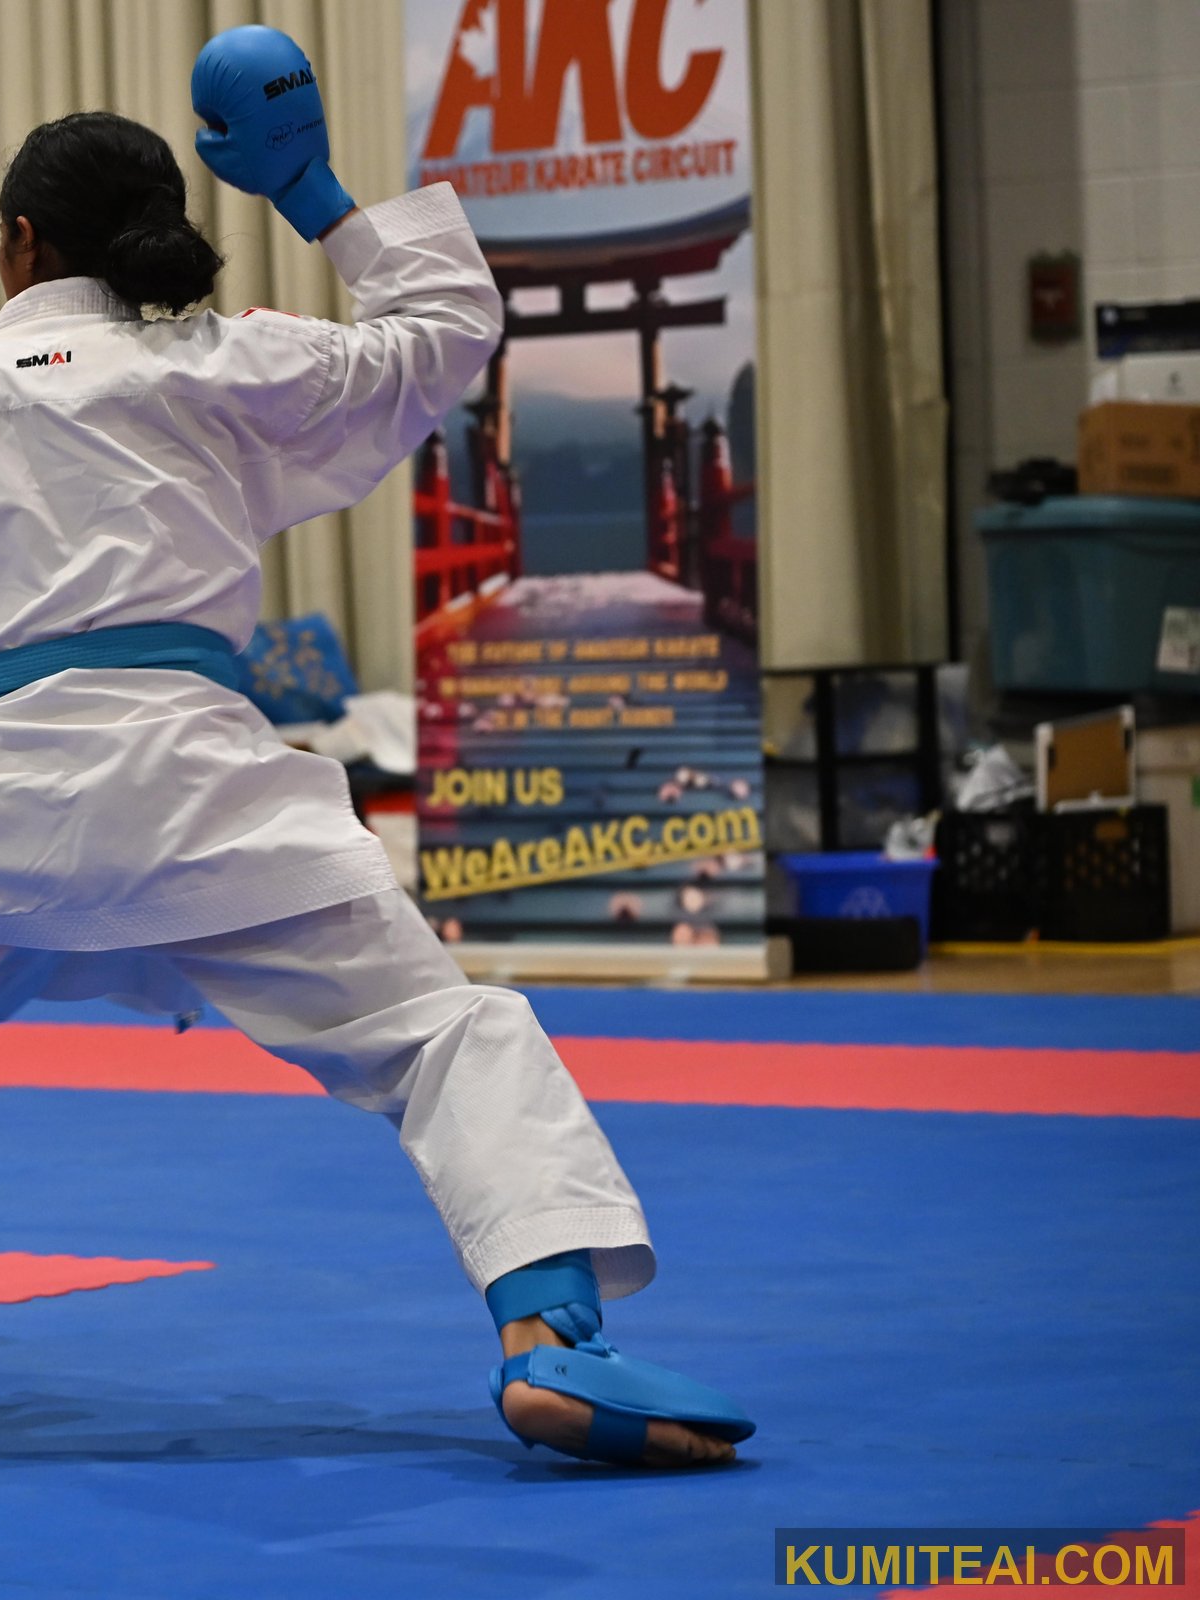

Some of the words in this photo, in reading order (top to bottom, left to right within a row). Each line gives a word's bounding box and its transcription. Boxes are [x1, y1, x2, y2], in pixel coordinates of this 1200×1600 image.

[423, 0, 725, 160] AKC
[534, 150, 626, 195] KARATE
[632, 140, 737, 184] CIRCUIT
[16, 350, 72, 368] SMAI
[427, 768, 506, 808] JOIN
[514, 767, 564, 806] US
[422, 806, 763, 893] WeAreAKC.com
